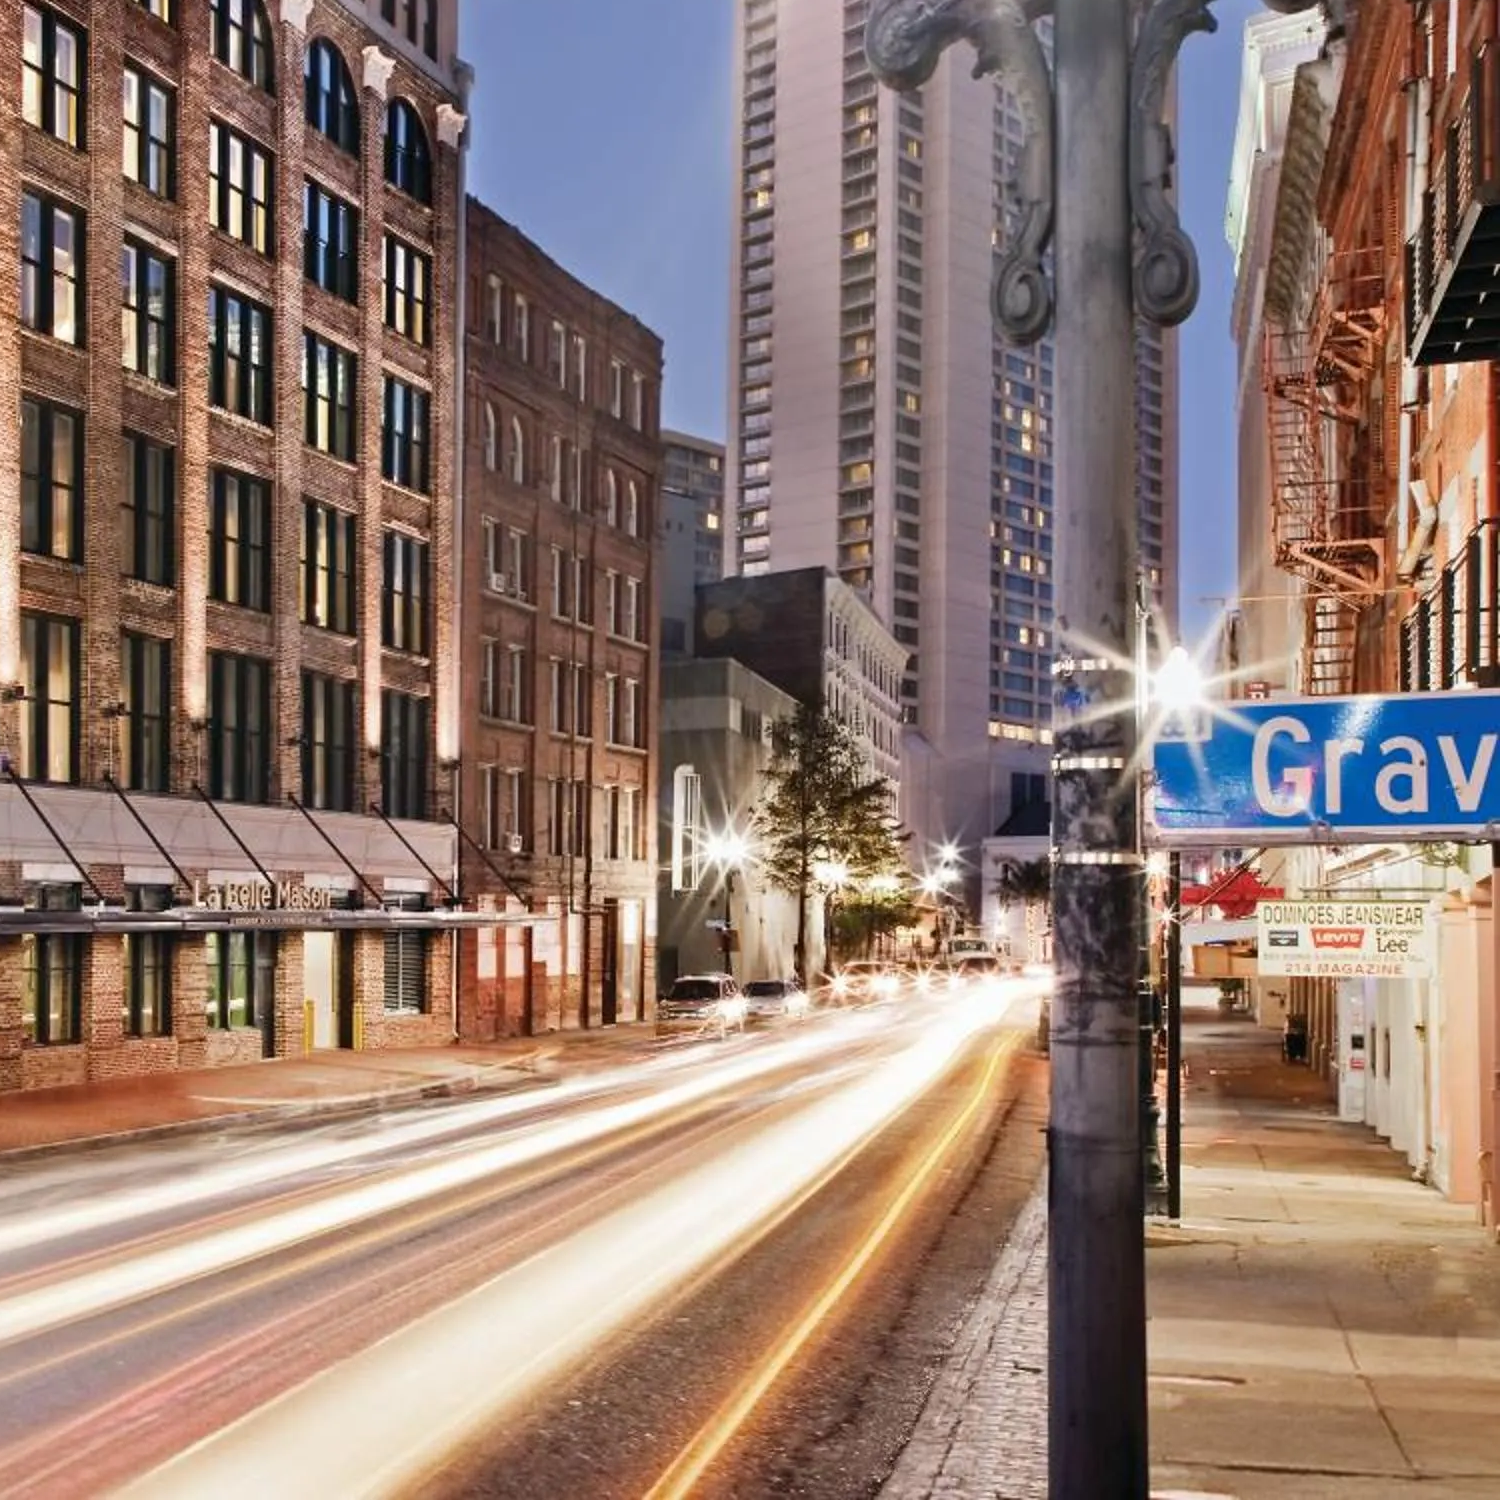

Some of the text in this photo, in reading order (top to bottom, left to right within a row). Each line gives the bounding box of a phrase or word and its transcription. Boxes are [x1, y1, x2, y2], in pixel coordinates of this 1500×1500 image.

[1251, 716, 1498, 817] Grav
[195, 879, 331, 909] La Belle Maison
[1263, 905, 1424, 924] DOMINOES JEANSWEAR
[1377, 937, 1409, 952] Lee
[1285, 963, 1404, 974] 214 MAGAZINE
